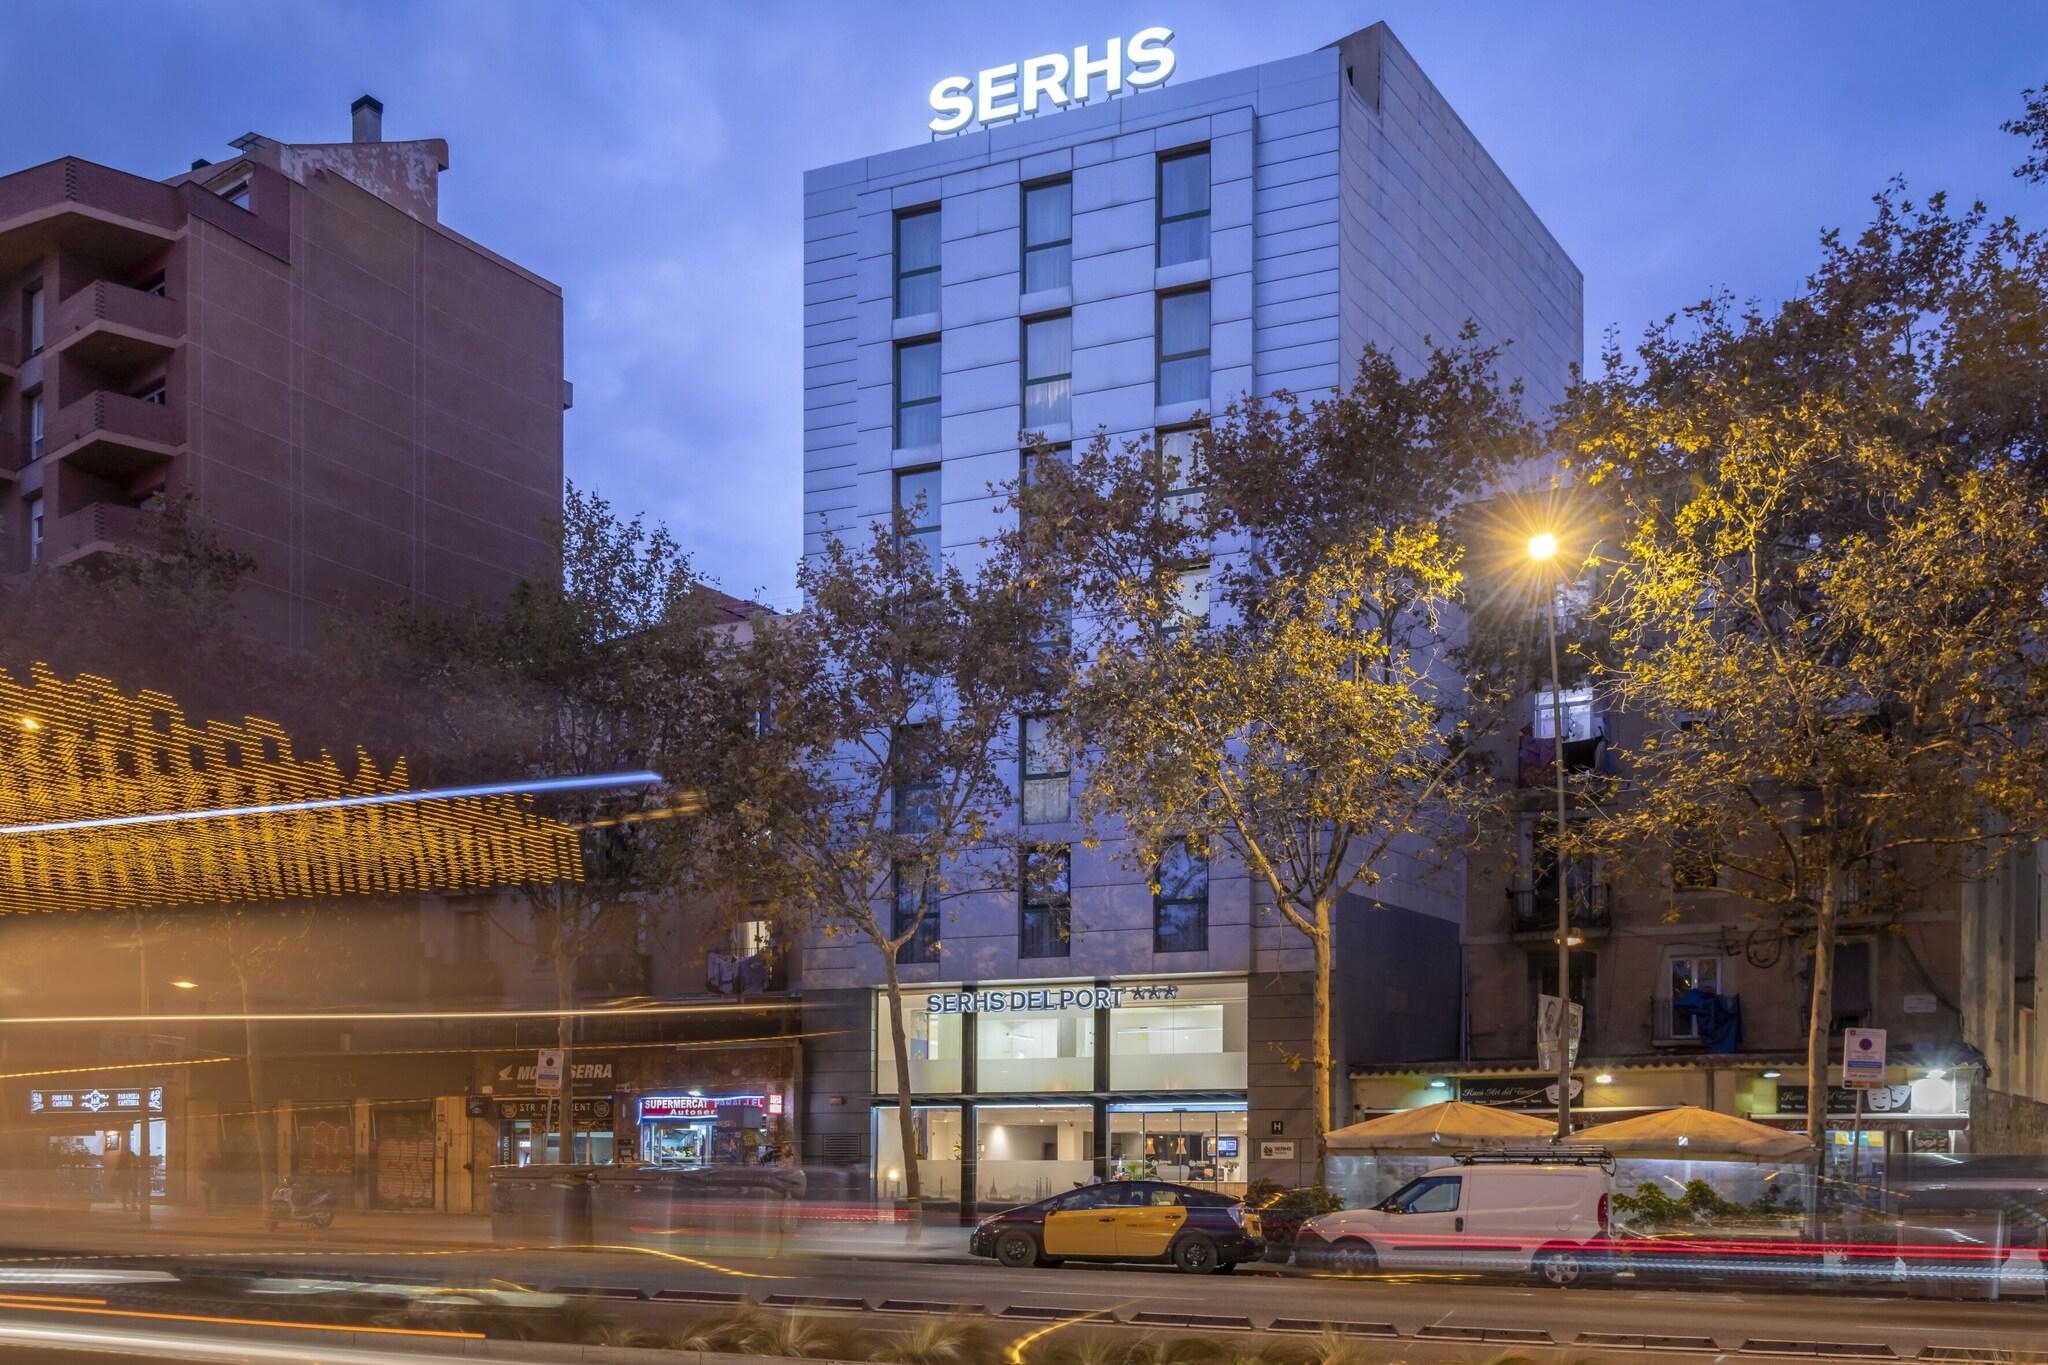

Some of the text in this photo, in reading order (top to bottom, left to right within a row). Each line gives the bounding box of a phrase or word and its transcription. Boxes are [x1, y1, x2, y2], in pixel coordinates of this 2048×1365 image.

[928, 27, 1175, 135] SERHS
[927, 986, 1123, 1014] SERHS DEL PORT
[644, 1099, 708, 1110] SUPERMERCAT
[670, 1107, 716, 1116] Autoser
[1273, 1122, 1281, 1131] H
